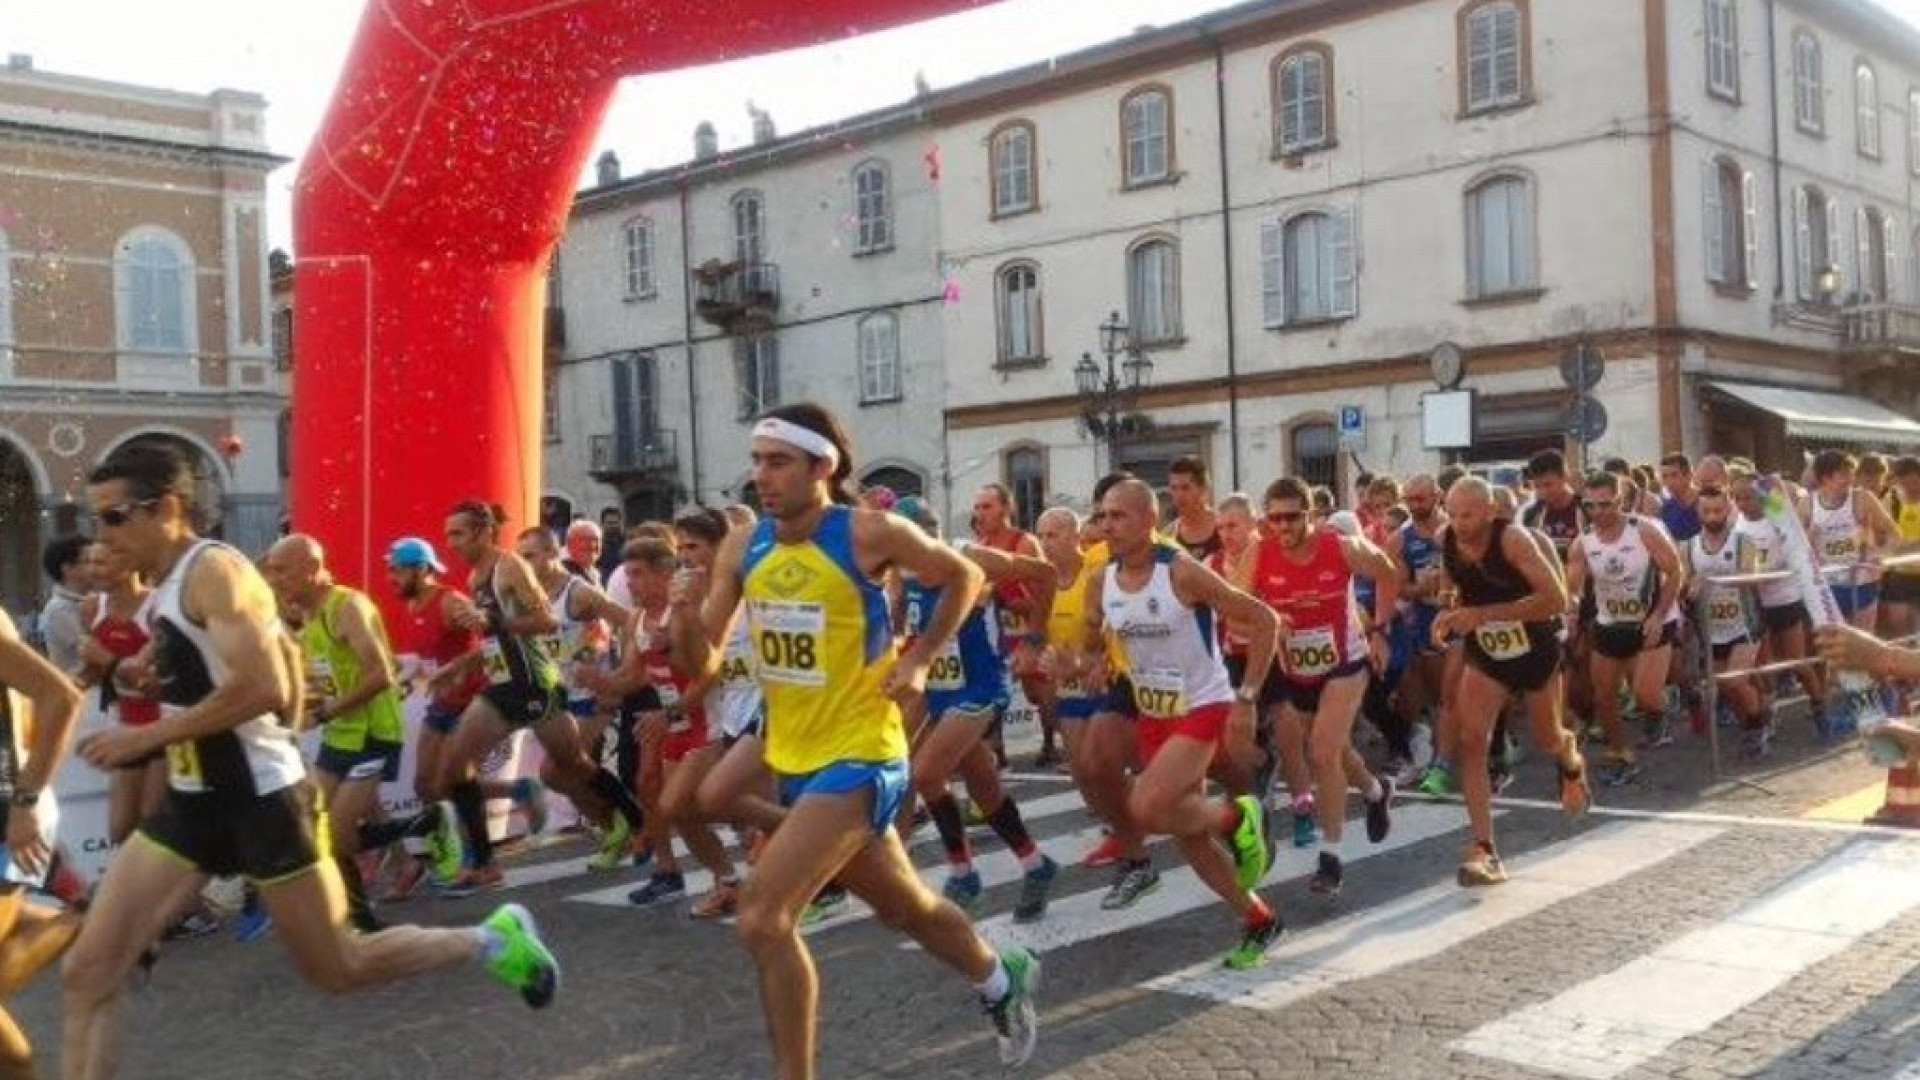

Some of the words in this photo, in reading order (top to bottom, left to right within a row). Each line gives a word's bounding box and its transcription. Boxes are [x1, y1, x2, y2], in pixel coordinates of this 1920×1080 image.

[761, 629, 817, 670] 018
[1481, 627, 1524, 652] 091
[1289, 642, 1335, 668] 006
[1137, 687, 1179, 713] 077
